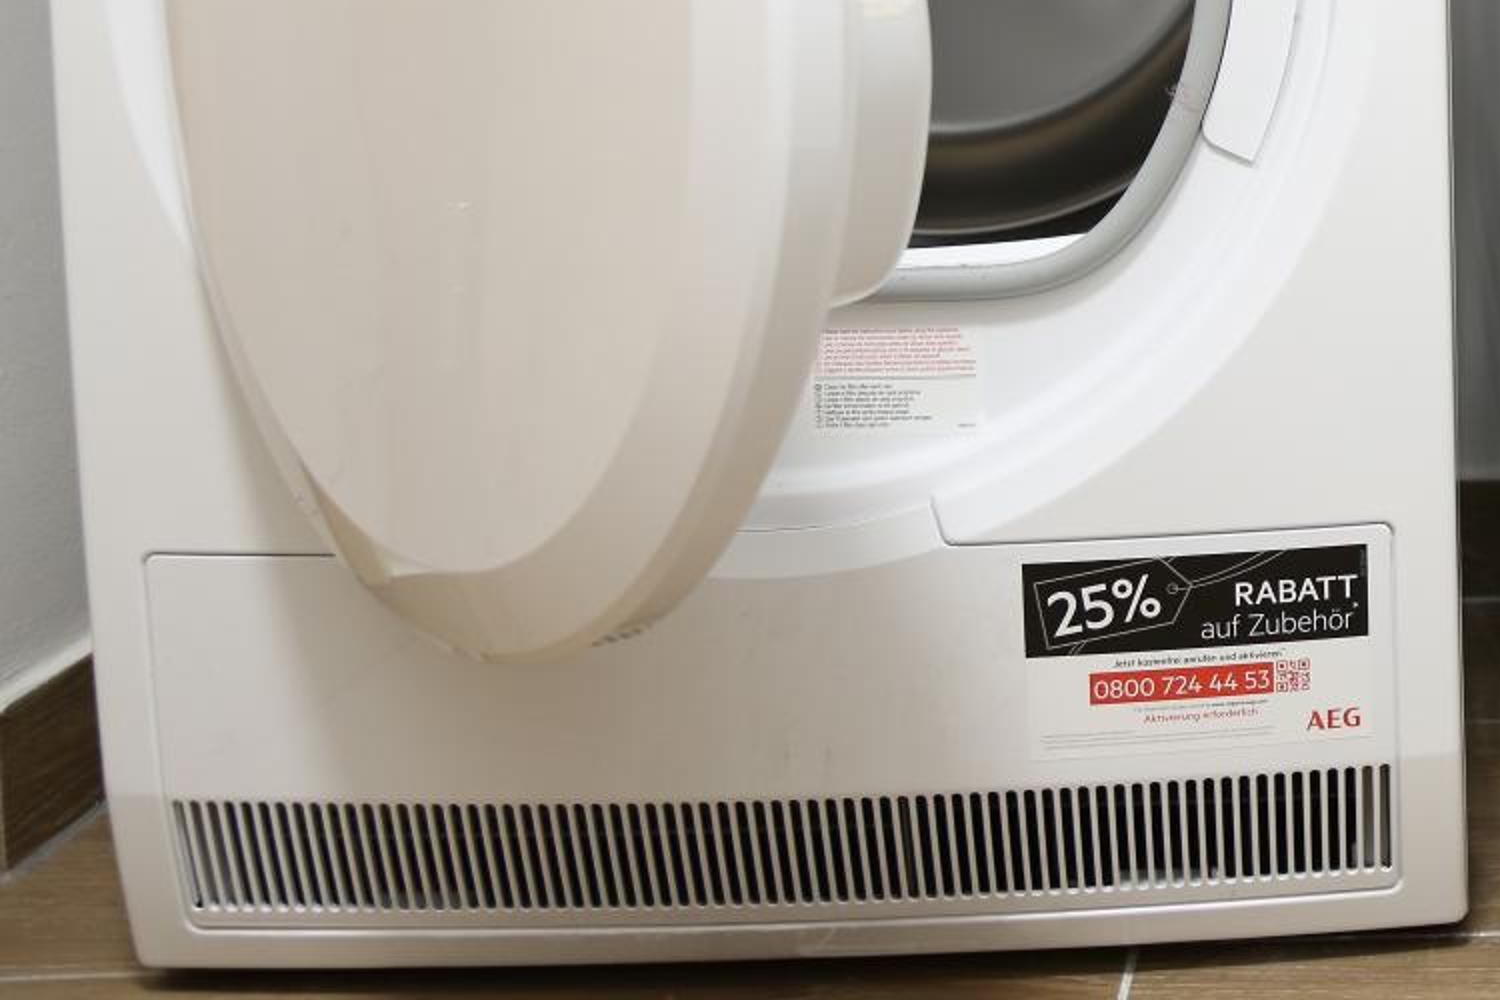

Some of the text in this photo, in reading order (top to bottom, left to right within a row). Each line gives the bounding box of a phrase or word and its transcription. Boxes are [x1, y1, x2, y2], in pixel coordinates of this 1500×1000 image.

[1046, 573, 1359, 638] 25% RABATT
[1200, 616, 1242, 640] auf
[1093, 669, 1270, 700] 0800 724 44 53
[1306, 706, 1362, 731] AEG
